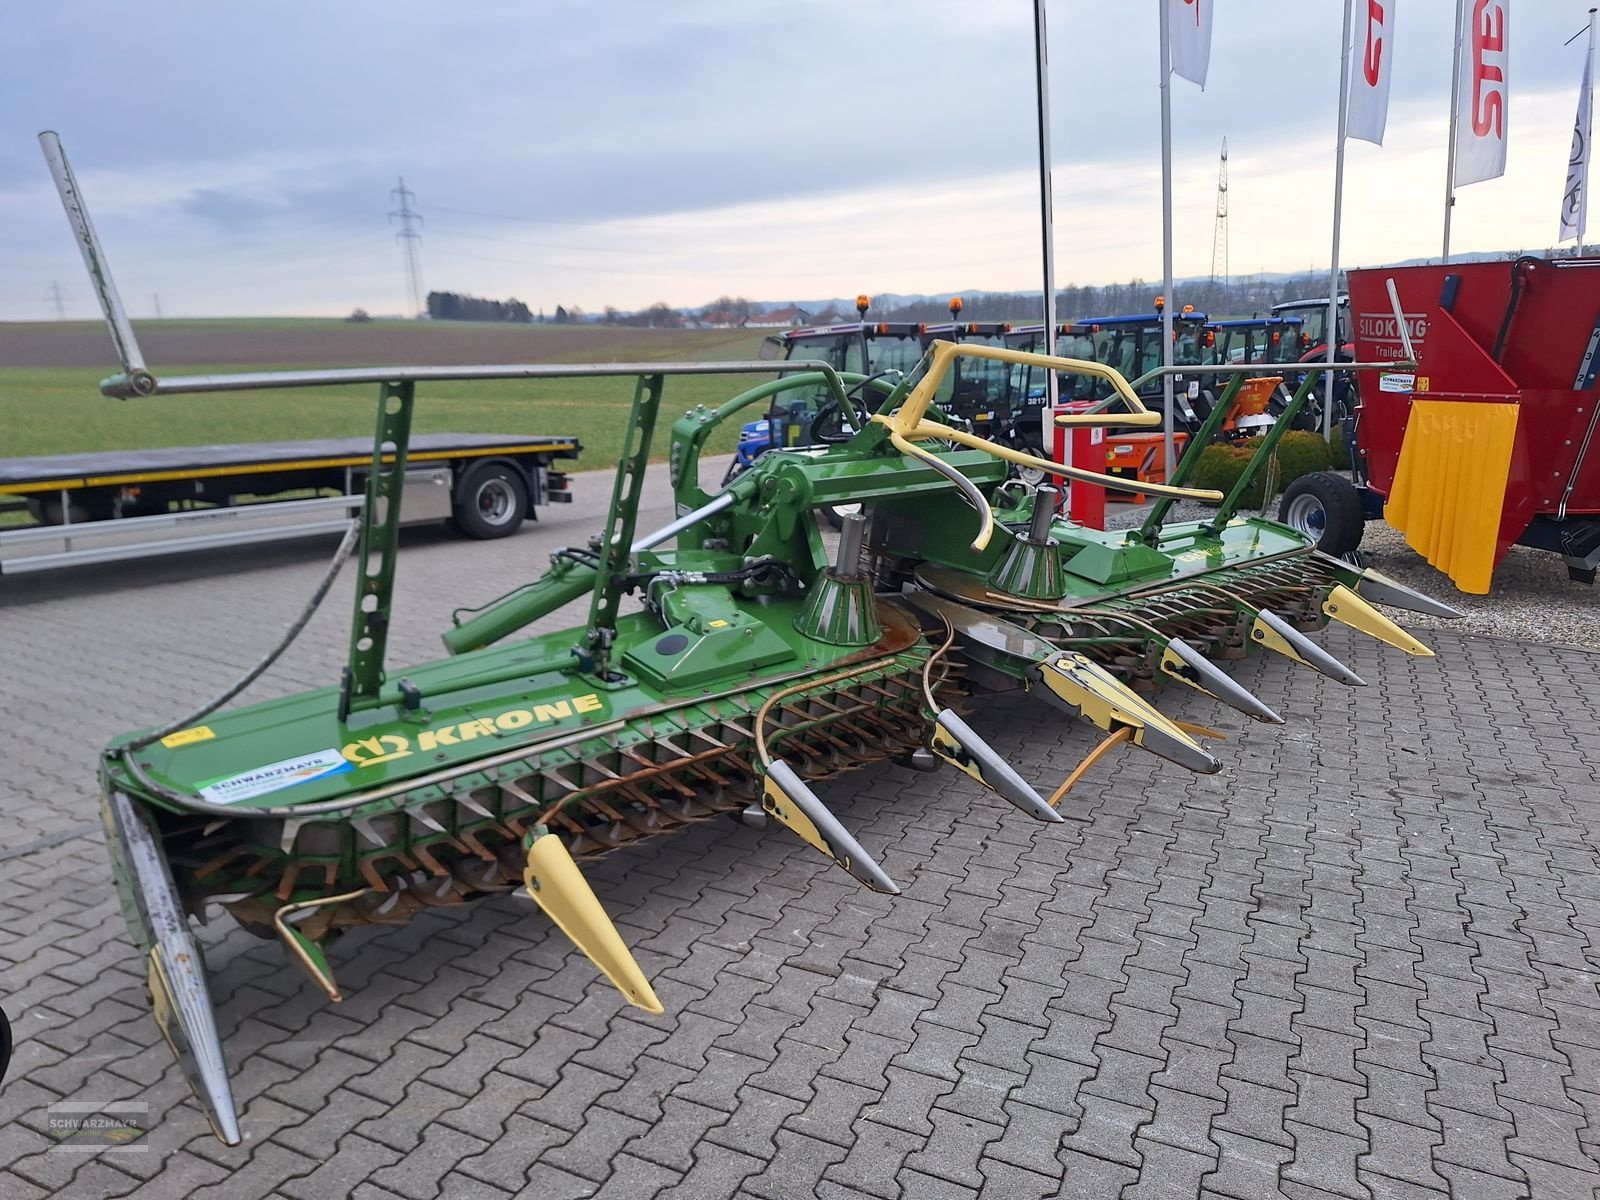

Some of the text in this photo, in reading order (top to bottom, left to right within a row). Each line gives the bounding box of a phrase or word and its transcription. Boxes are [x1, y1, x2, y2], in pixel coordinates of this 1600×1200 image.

[1585, 352, 1592, 360] 3
[1577, 374, 1584, 382] 2
[417, 693, 603, 751] KRONE
[211, 758, 323, 791] SCHWARZMAYR
